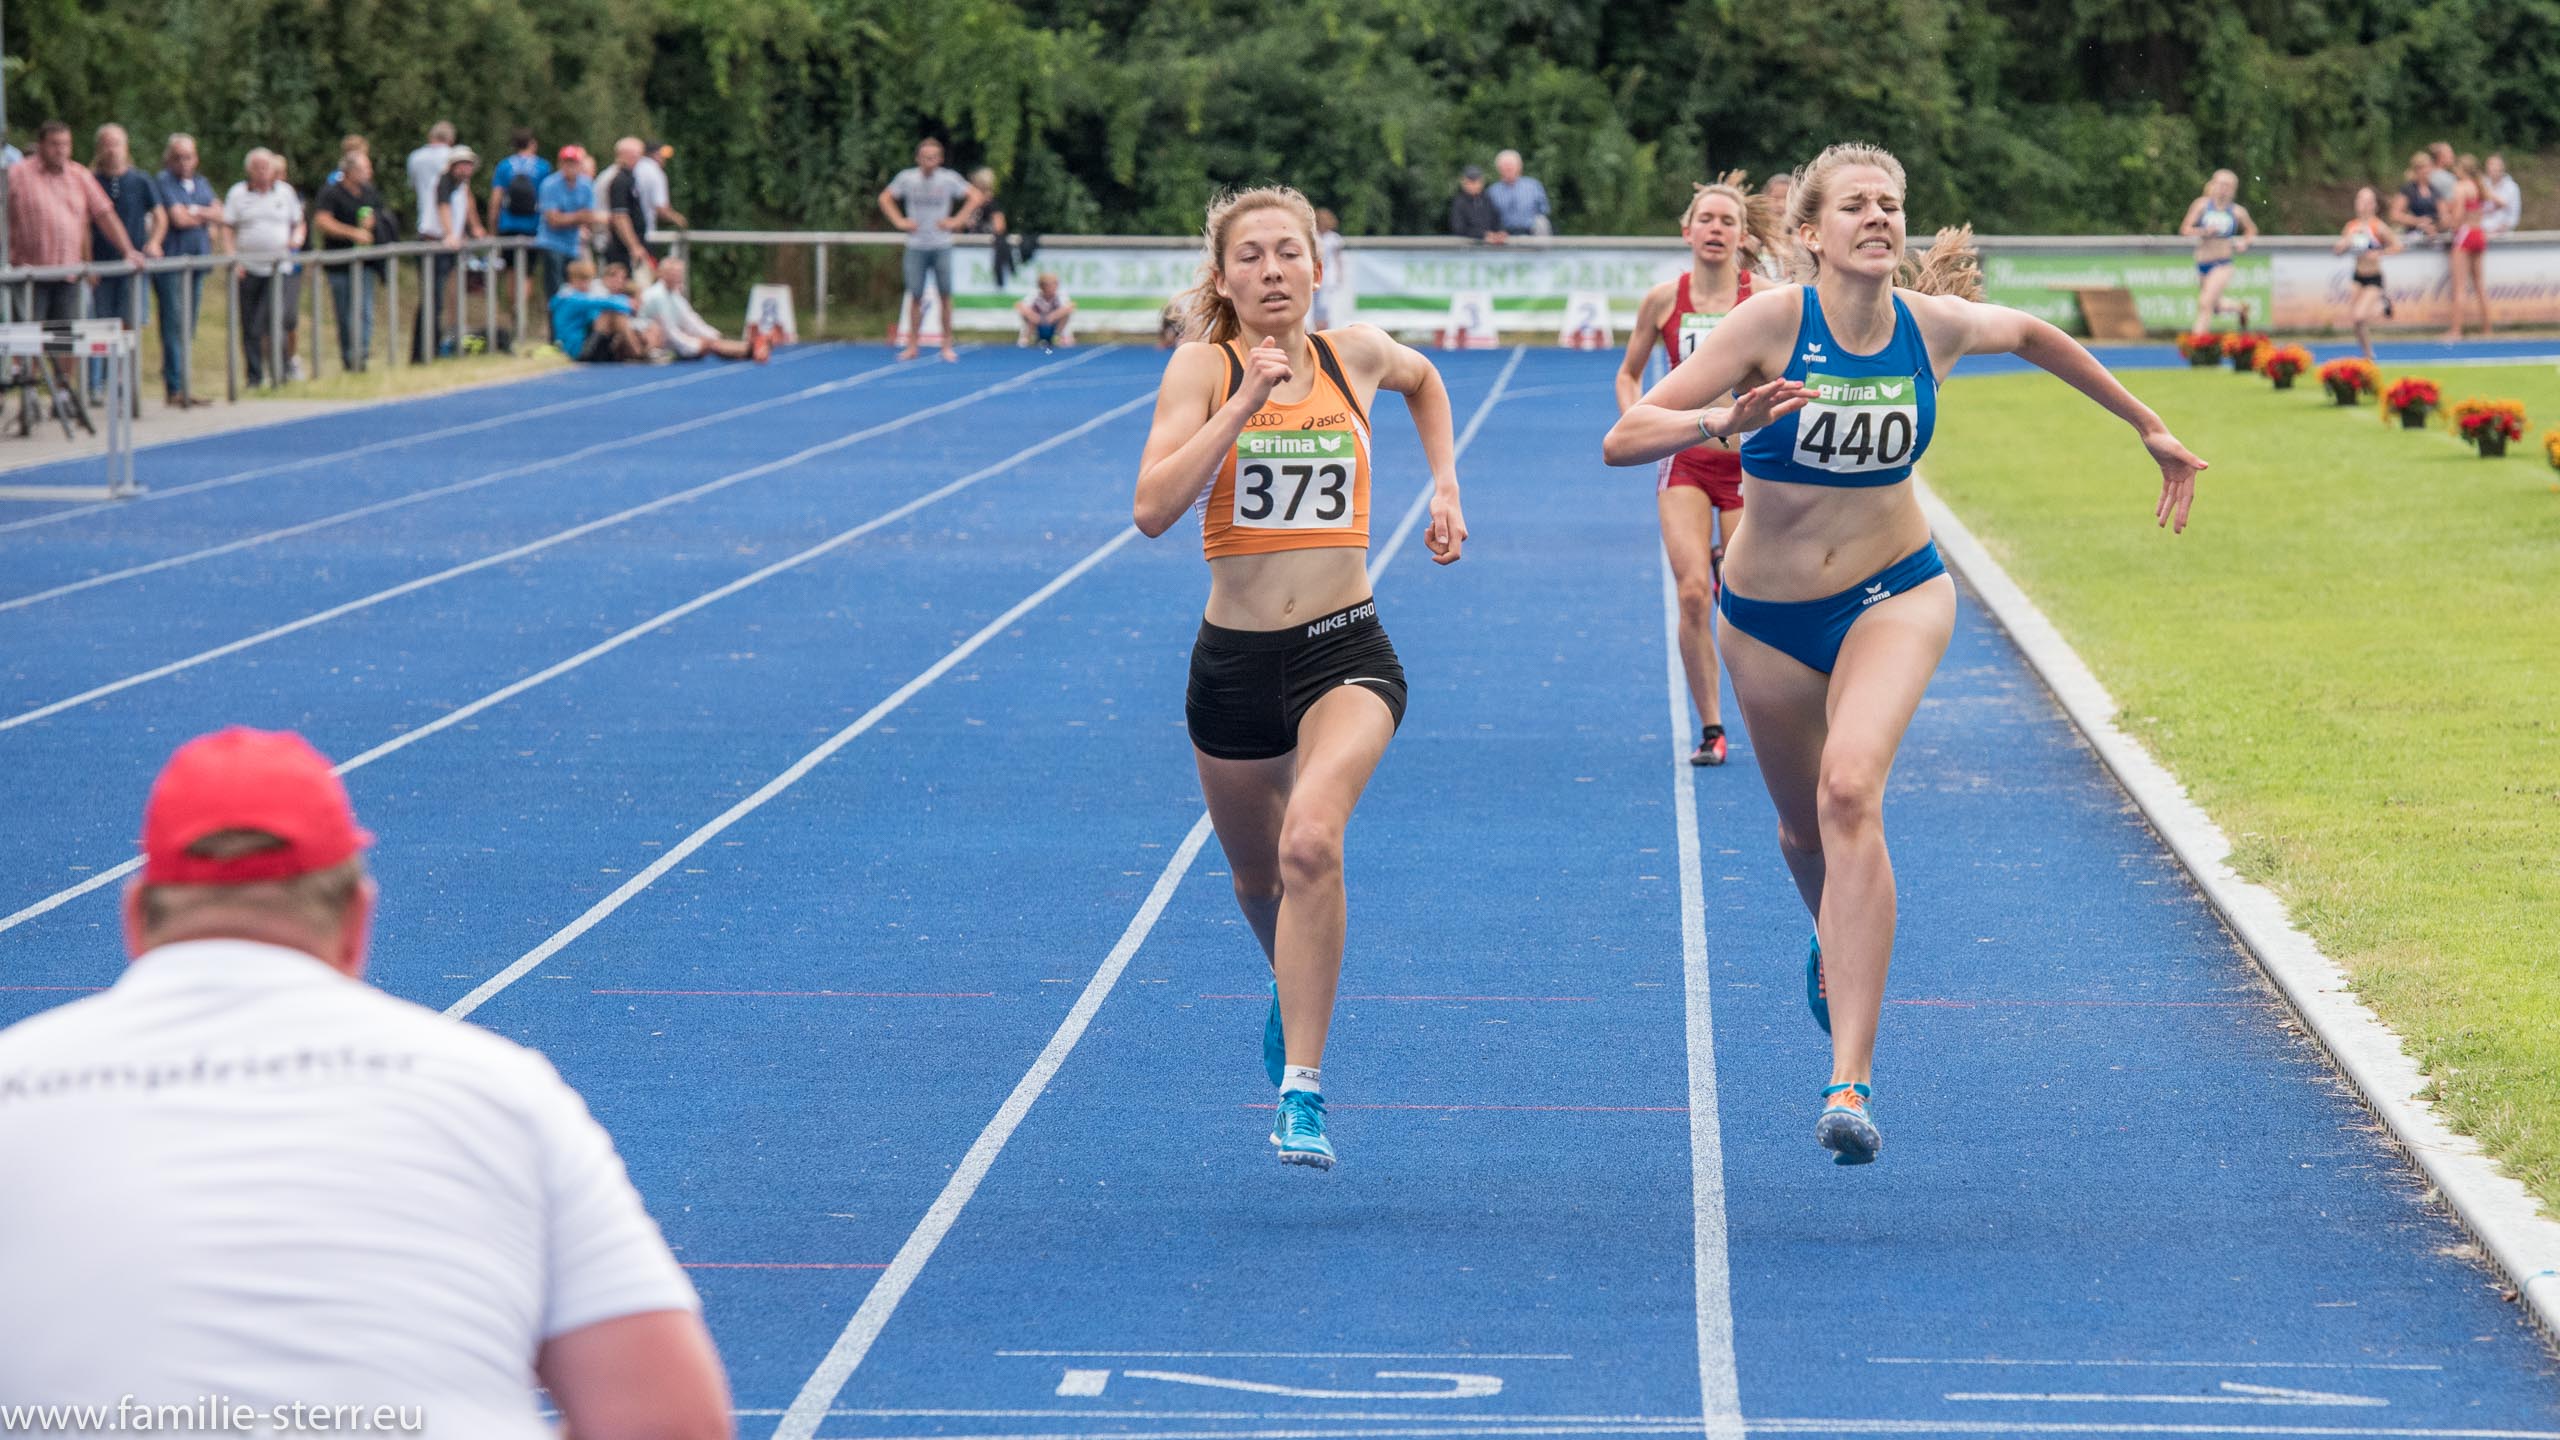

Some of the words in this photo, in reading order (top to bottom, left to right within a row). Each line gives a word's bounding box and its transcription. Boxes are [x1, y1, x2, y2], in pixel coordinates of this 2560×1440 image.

[1404, 260, 1534, 287] MEINE
[1802, 353, 1827, 363] erima
[1819, 383, 1879, 401] erima
[1316, 412, 1346, 428] asics
[1250, 438, 1316, 454] erima
[1800, 411, 1912, 465] 440
[1240, 464, 1347, 521] 373
[1863, 590, 1891, 606] erima
[1307, 613, 1347, 638] NIKE
[1350, 602, 1375, 623] PRO
